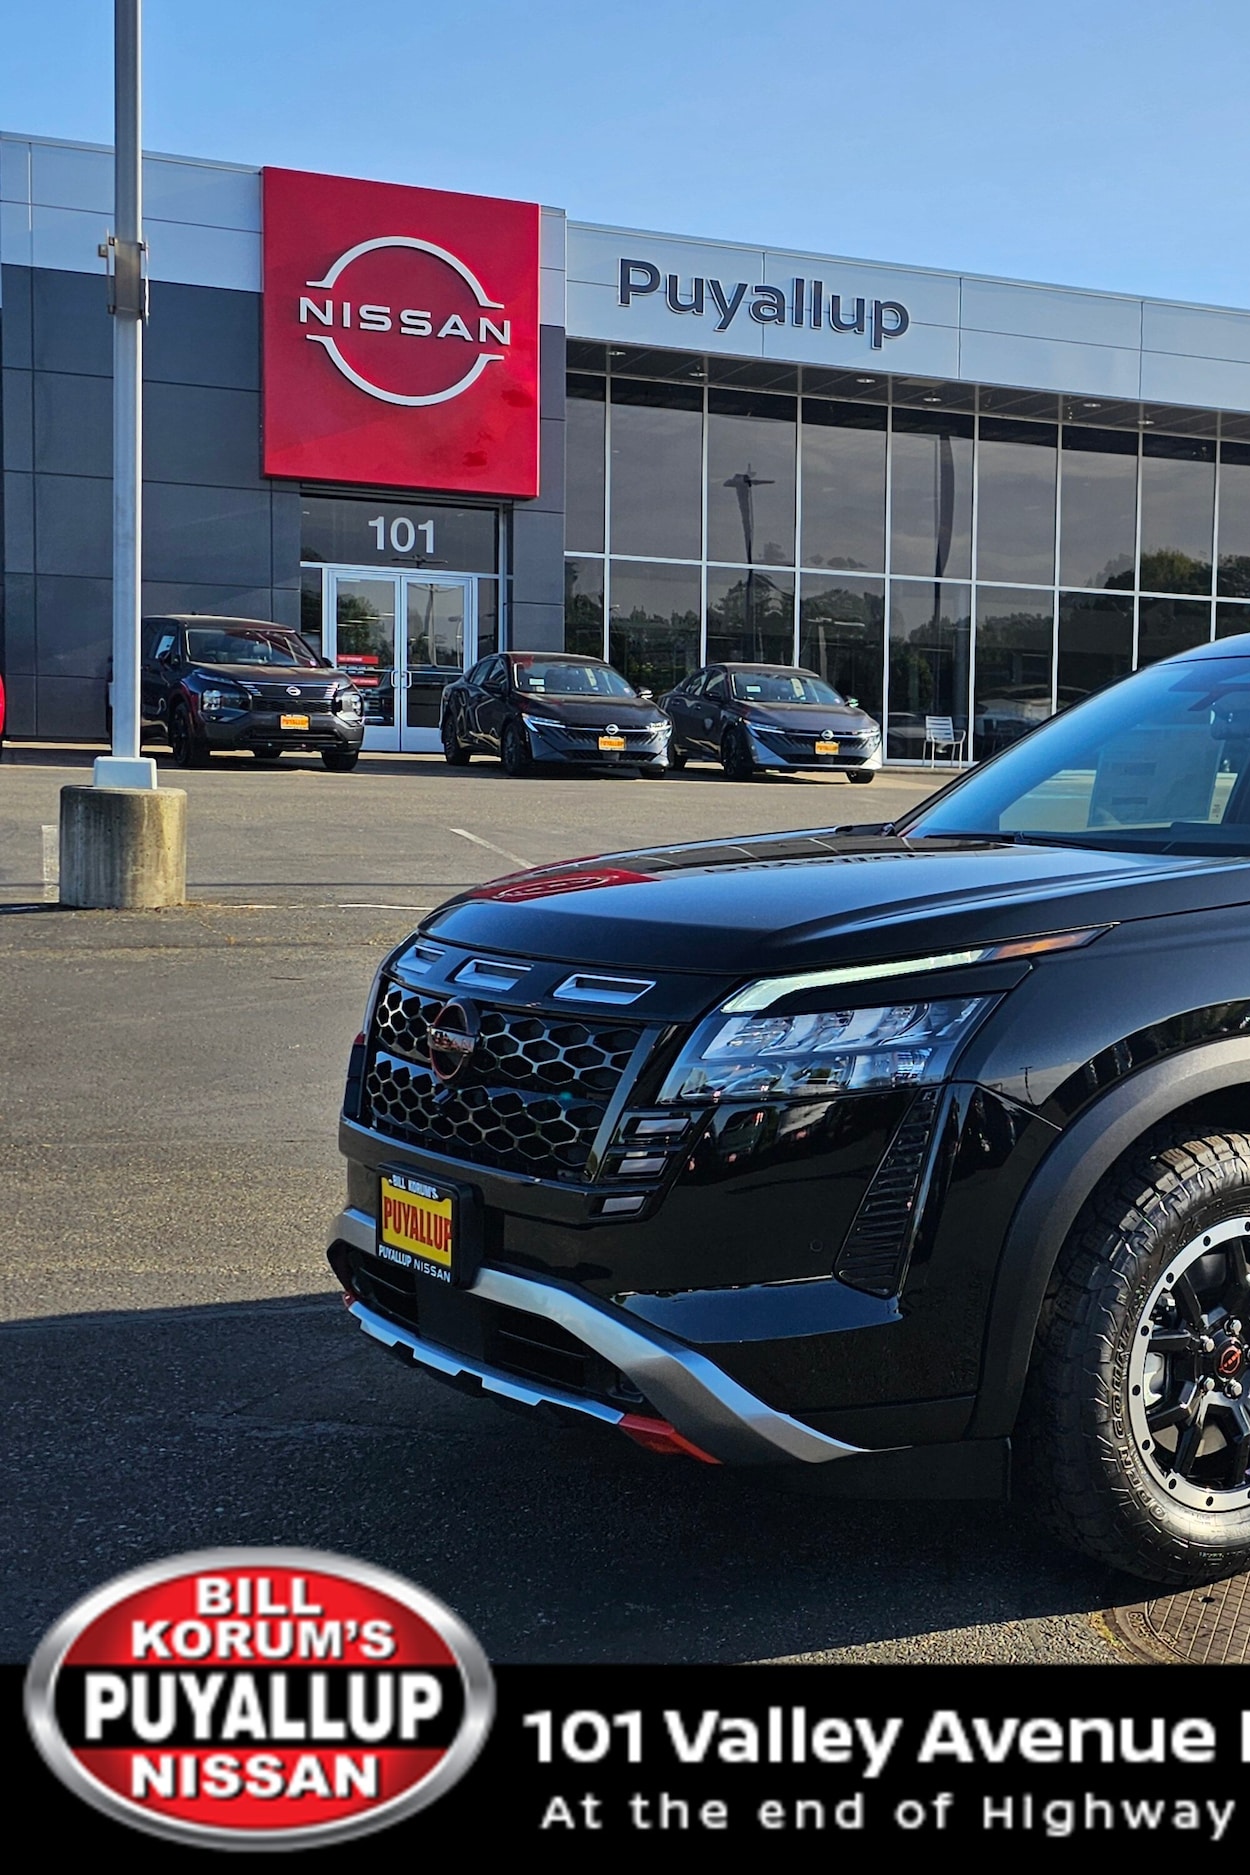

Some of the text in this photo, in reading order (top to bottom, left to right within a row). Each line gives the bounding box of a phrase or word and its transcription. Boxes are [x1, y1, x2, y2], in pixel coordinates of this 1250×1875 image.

[299, 295, 512, 346] NISSAN
[617, 257, 911, 349] Puyallup
[368, 516, 434, 553] 101
[392, 1174, 407, 1190] BILL
[383, 1195, 453, 1253] PUYALLUP
[378, 1244, 452, 1283] PUYALLUP NISSAN
